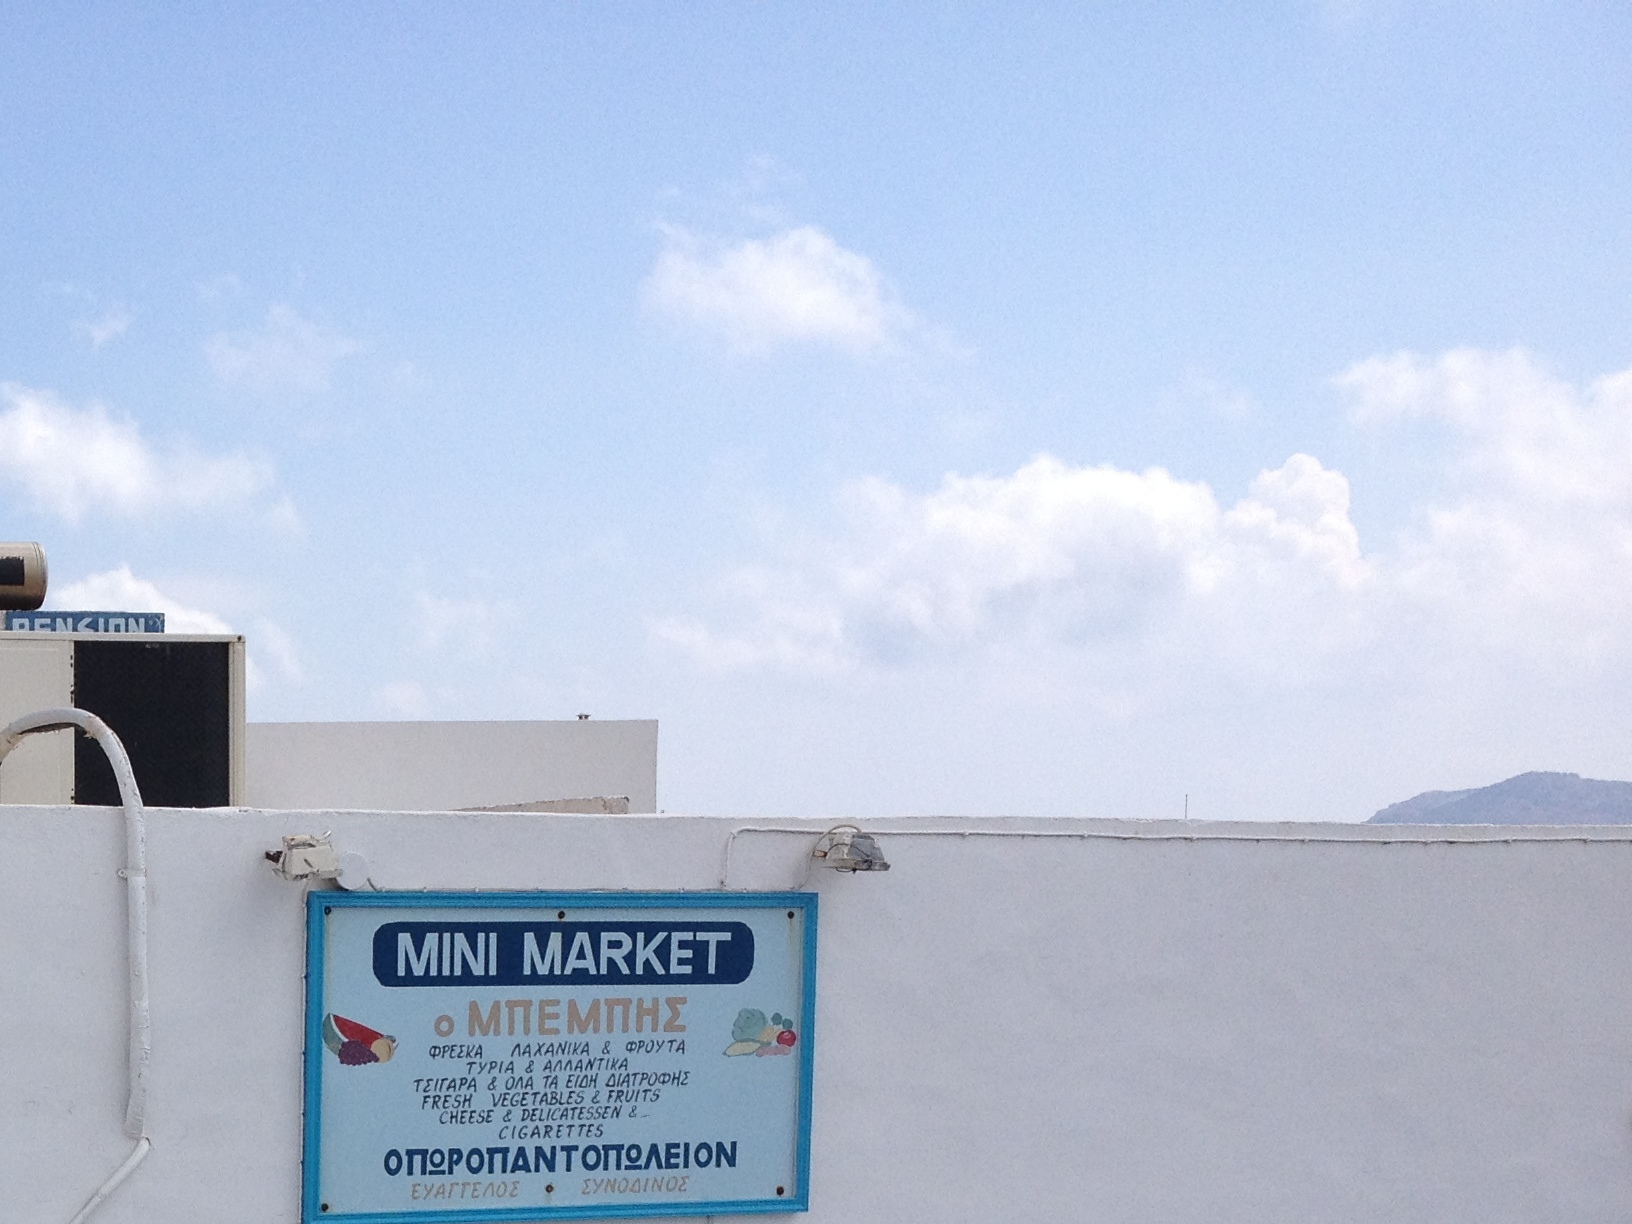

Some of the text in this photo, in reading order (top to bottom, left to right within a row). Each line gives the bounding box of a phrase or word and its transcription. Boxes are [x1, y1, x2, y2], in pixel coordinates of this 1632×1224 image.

[397, 930, 733, 977] MINI MARKET
[467, 996, 688, 1037] ΜΠΕΜΠΗΣ
[429, 1039, 686, 1060] ΦΡΕΣΚΑ ΛΑΧΑΝΙΚΑ & ΦΡΟΥΤΑ
[466, 1057, 629, 1075] ΤΥΡΙΑ & ΑΛΛΑΝΤΙΚΑ
[413, 1070, 691, 1093] ΤΣΙΓΑΡΑ & ΟΛΑ ΤΑ ΕΙΔΗ ΔΙΑΤΡΟΦΗΣ
[422, 1088, 661, 1110] FRESH VEGETABLES & FRUITS
[439, 1109, 494, 1125] CHEESE
[502, 1109, 512, 1123] &
[520, 1105, 623, 1123] DELICATESSEN
[498, 1123, 604, 1140] CIGARETTES
[383, 1140, 738, 1176] ΟΠΩΡΟΠΑΝΤΟΠΩΛΕΙΟΝ
[410, 1175, 690, 1200] ΕΥΑΓΓΕΛΟΣ ΣΥΝΟΔΙΝΟΣ
